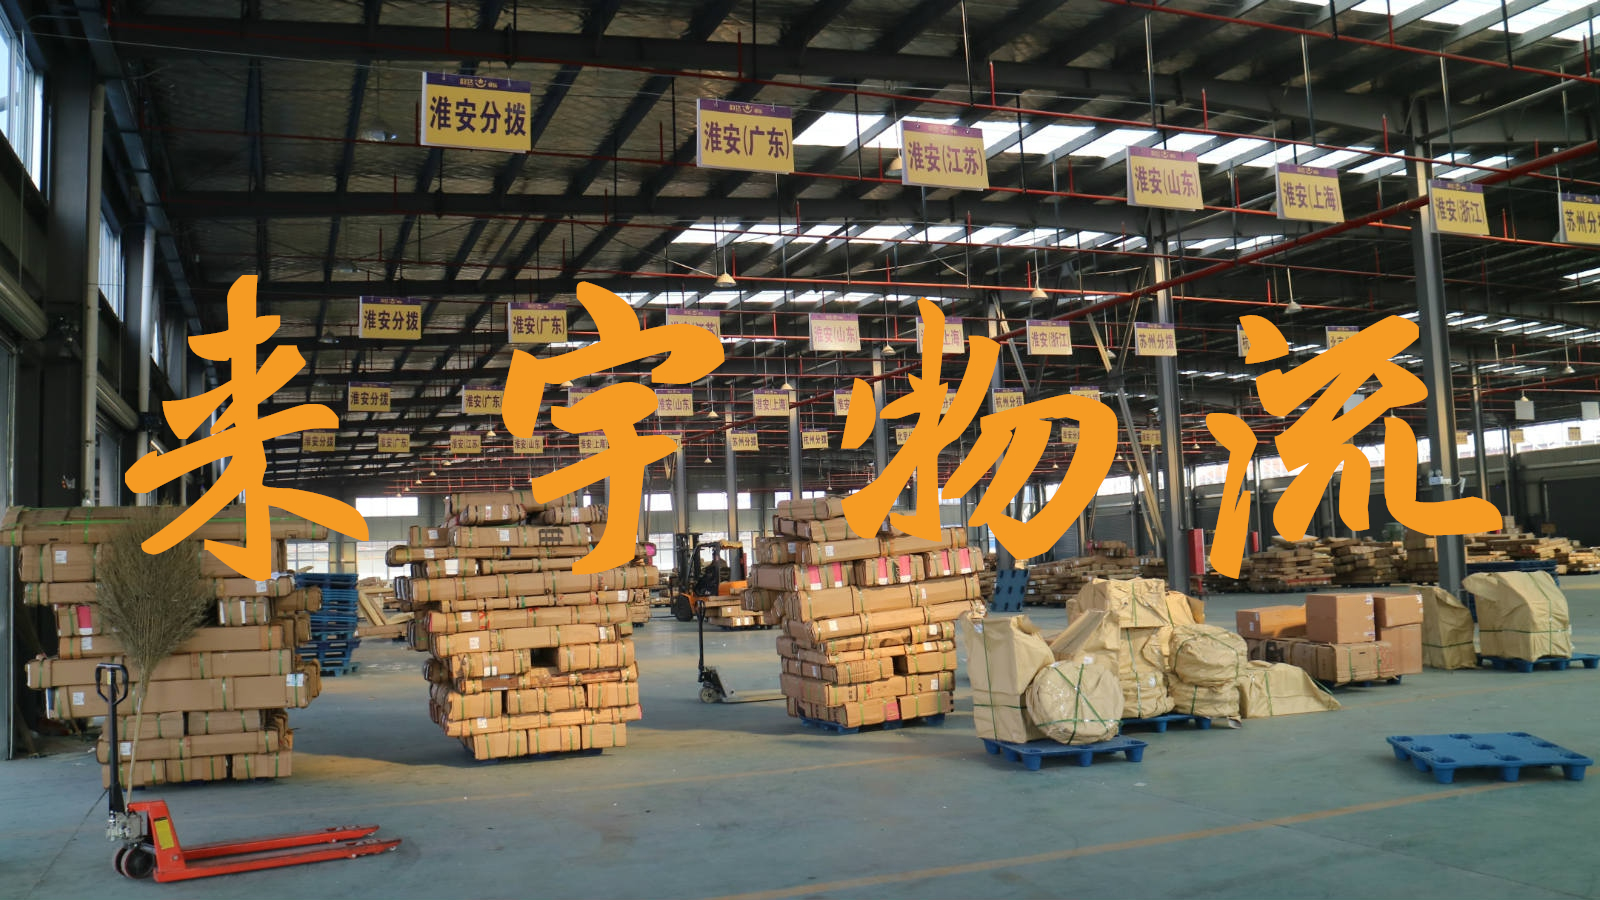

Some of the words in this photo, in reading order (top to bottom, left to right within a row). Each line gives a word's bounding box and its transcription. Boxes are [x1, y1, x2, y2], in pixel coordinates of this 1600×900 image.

[430, 96, 526, 136] 淮安分拨
[704, 121, 789, 160] 淮安(广东)
[908, 141, 983, 176] 淮安(江苏)
[1135, 166, 1198, 197] 淮安(山东)
[1283, 182, 1339, 211] 淮安(上海)
[1565, 209, 1600, 234] 苏州分
[364, 310, 418, 331] 淮安分拨
[513, 316, 565, 335] 淮安(广东)
[351, 392, 388, 405] 淮安分拨
